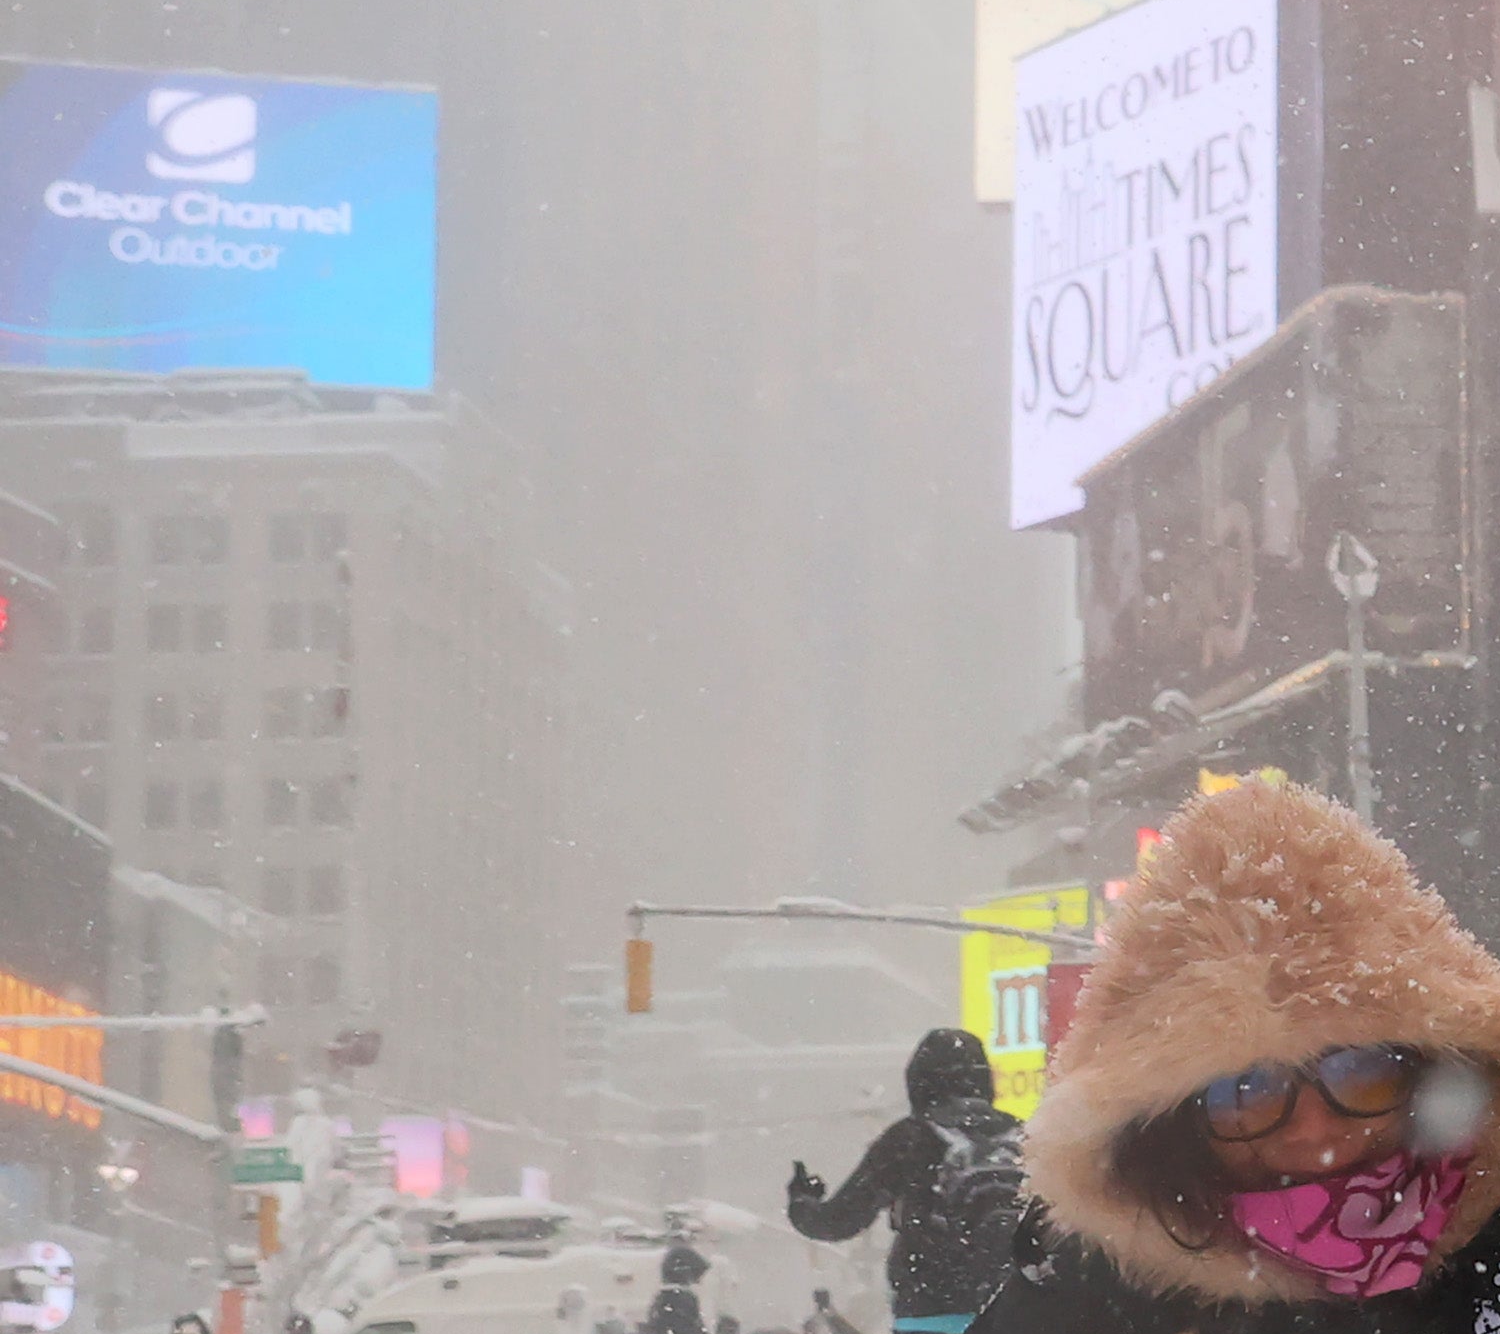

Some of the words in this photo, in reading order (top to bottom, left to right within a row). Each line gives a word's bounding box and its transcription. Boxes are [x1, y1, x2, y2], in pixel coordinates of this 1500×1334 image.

[1024, 45, 1203, 157] WELCOME
[1210, 25, 1256, 84] TO
[44, 179, 168, 226] Clear
[171, 189, 352, 236] Channel
[108, 224, 284, 270] Outdoor
[1116, 122, 1256, 250] TIMES
[1021, 213, 1254, 425] SQUARE
